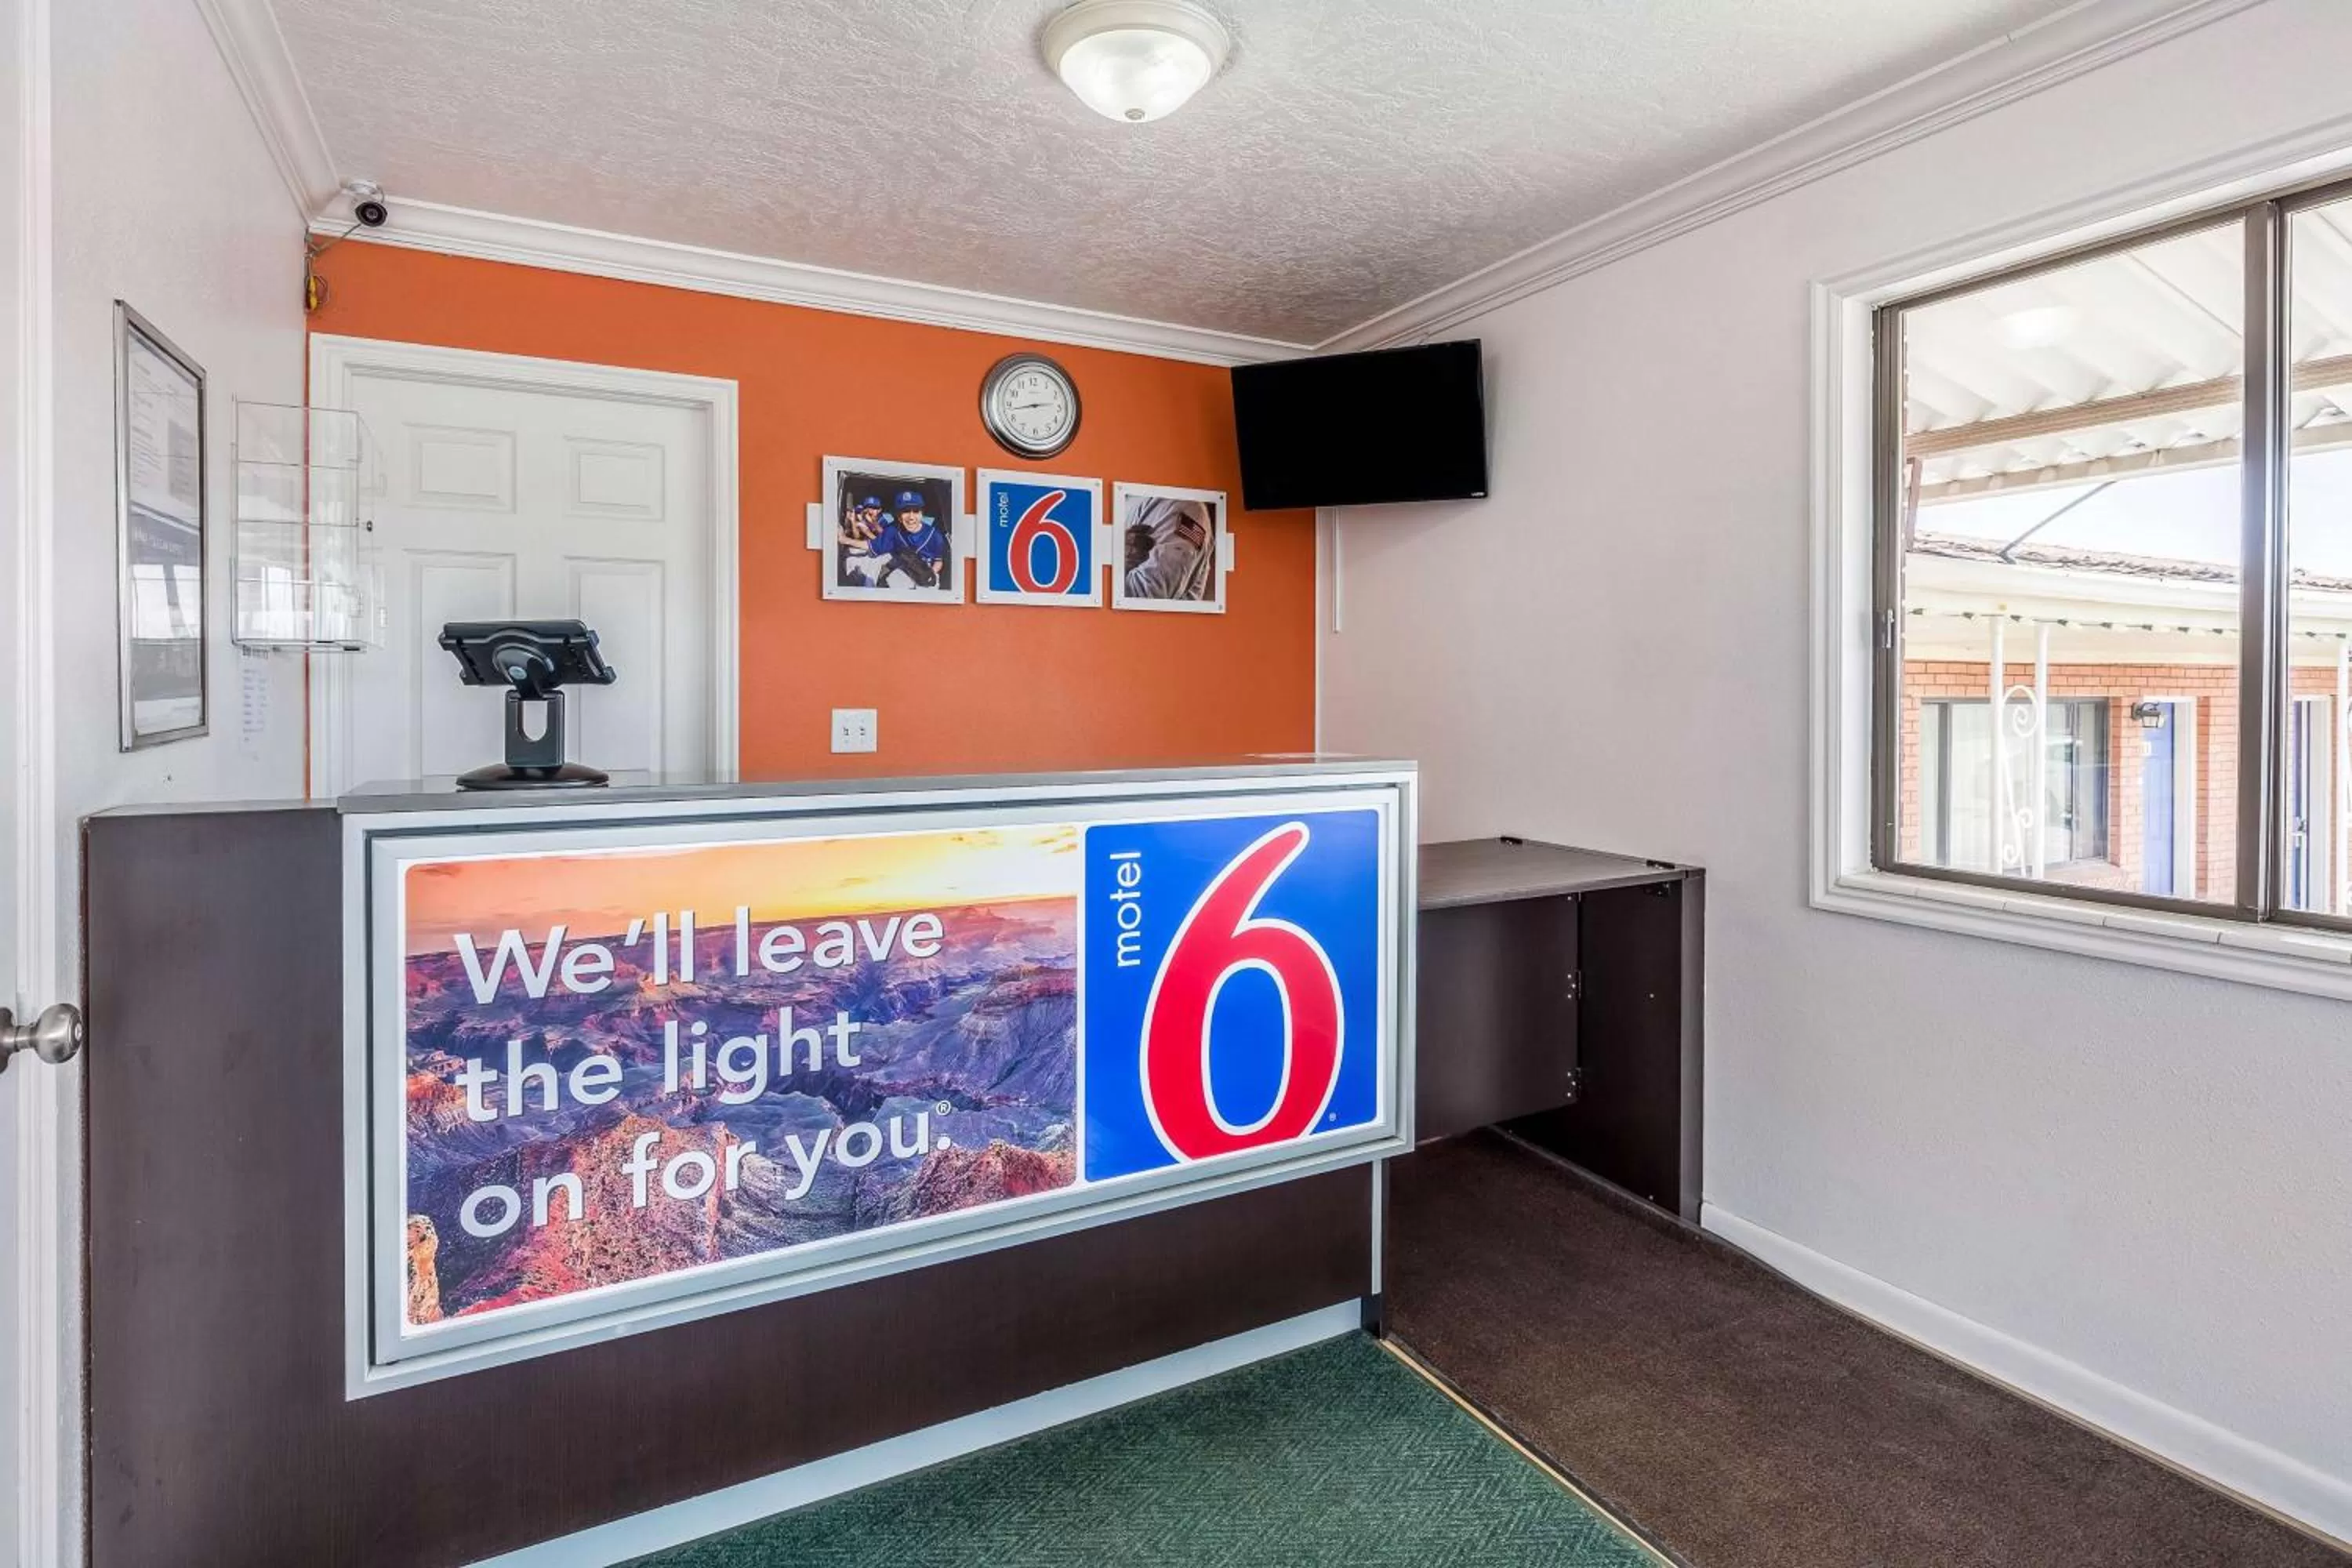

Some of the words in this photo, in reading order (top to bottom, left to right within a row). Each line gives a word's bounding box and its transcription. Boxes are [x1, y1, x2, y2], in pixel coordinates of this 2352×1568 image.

[997, 492, 1010, 528] motel
[1007, 490, 1080, 594] 6
[454, 909, 695, 1005] We'll
[735, 906, 944, 977] leave
[1109, 851, 1142, 967] motel
[1139, 821, 1345, 1164] 6
[455, 1040, 623, 1123] the
[664, 1007, 862, 1105] light
[459, 1171, 584, 1239] on
[622, 1131, 757, 1208] for
